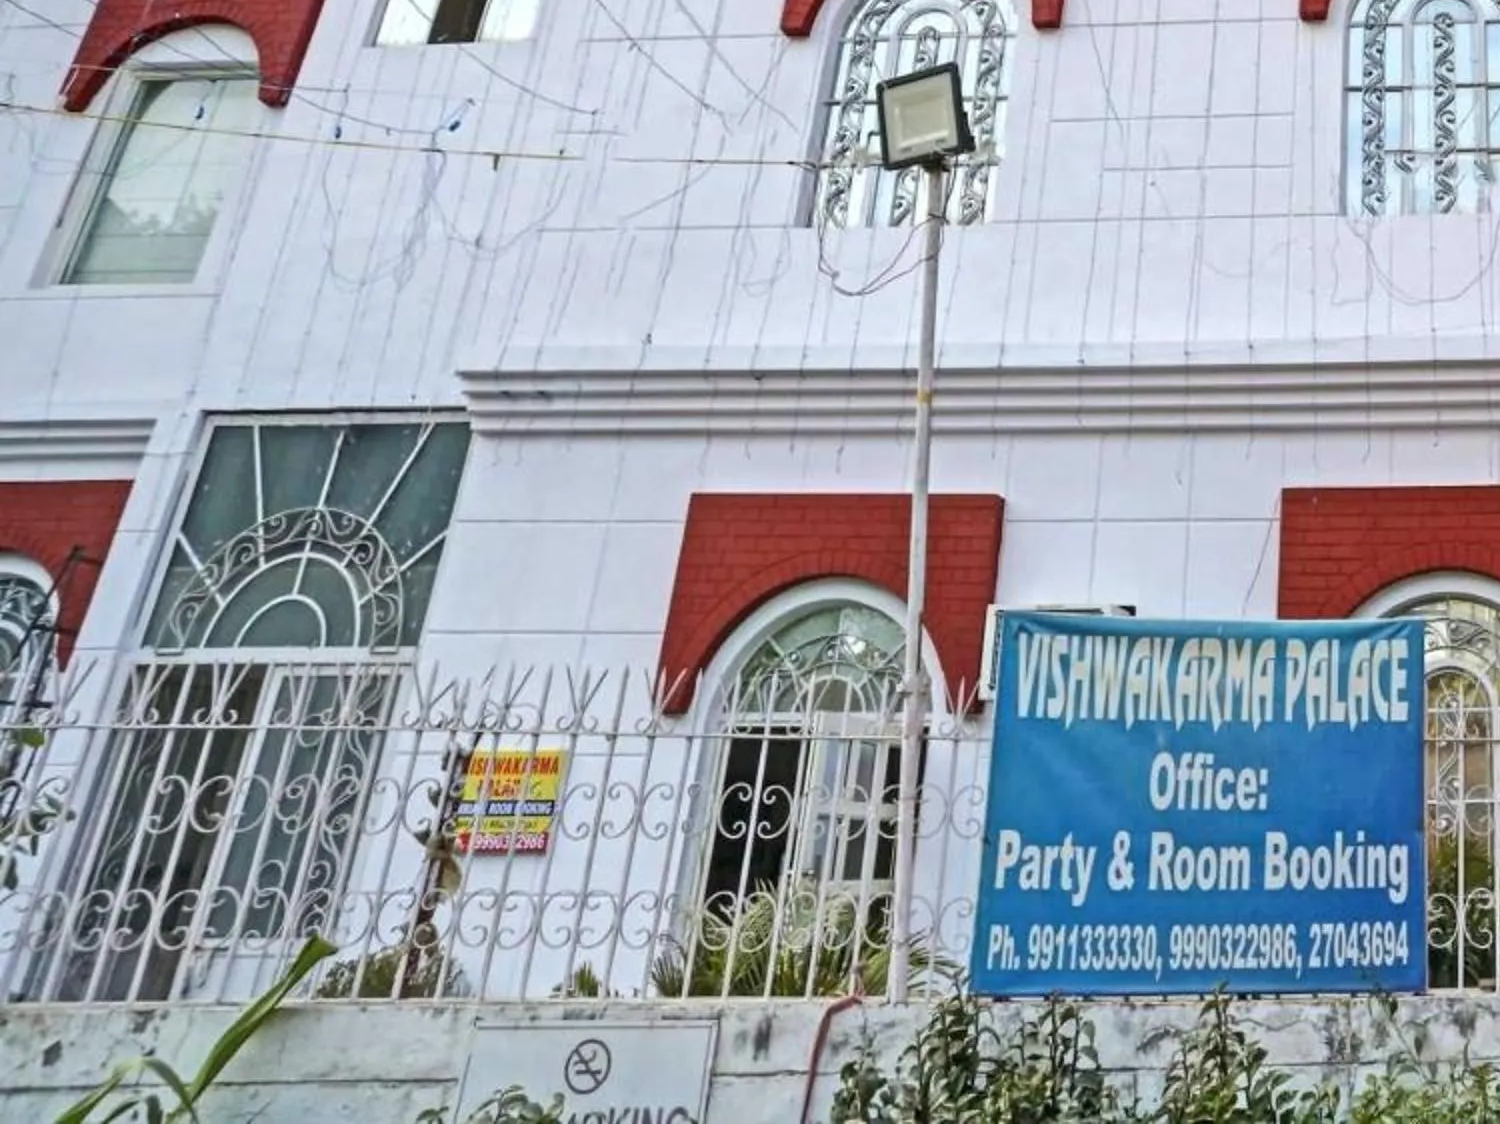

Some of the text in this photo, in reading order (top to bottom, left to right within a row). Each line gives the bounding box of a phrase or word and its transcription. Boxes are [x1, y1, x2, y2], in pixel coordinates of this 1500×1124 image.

[1017, 633, 1409, 732] VISHWAKARMA PALACE
[1149, 751, 1269, 812] Office:
[994, 829, 1409, 907] Party & Room Booking
[986, 920, 1409, 981] Ph. 9911333330, 9990322986, 27043694
